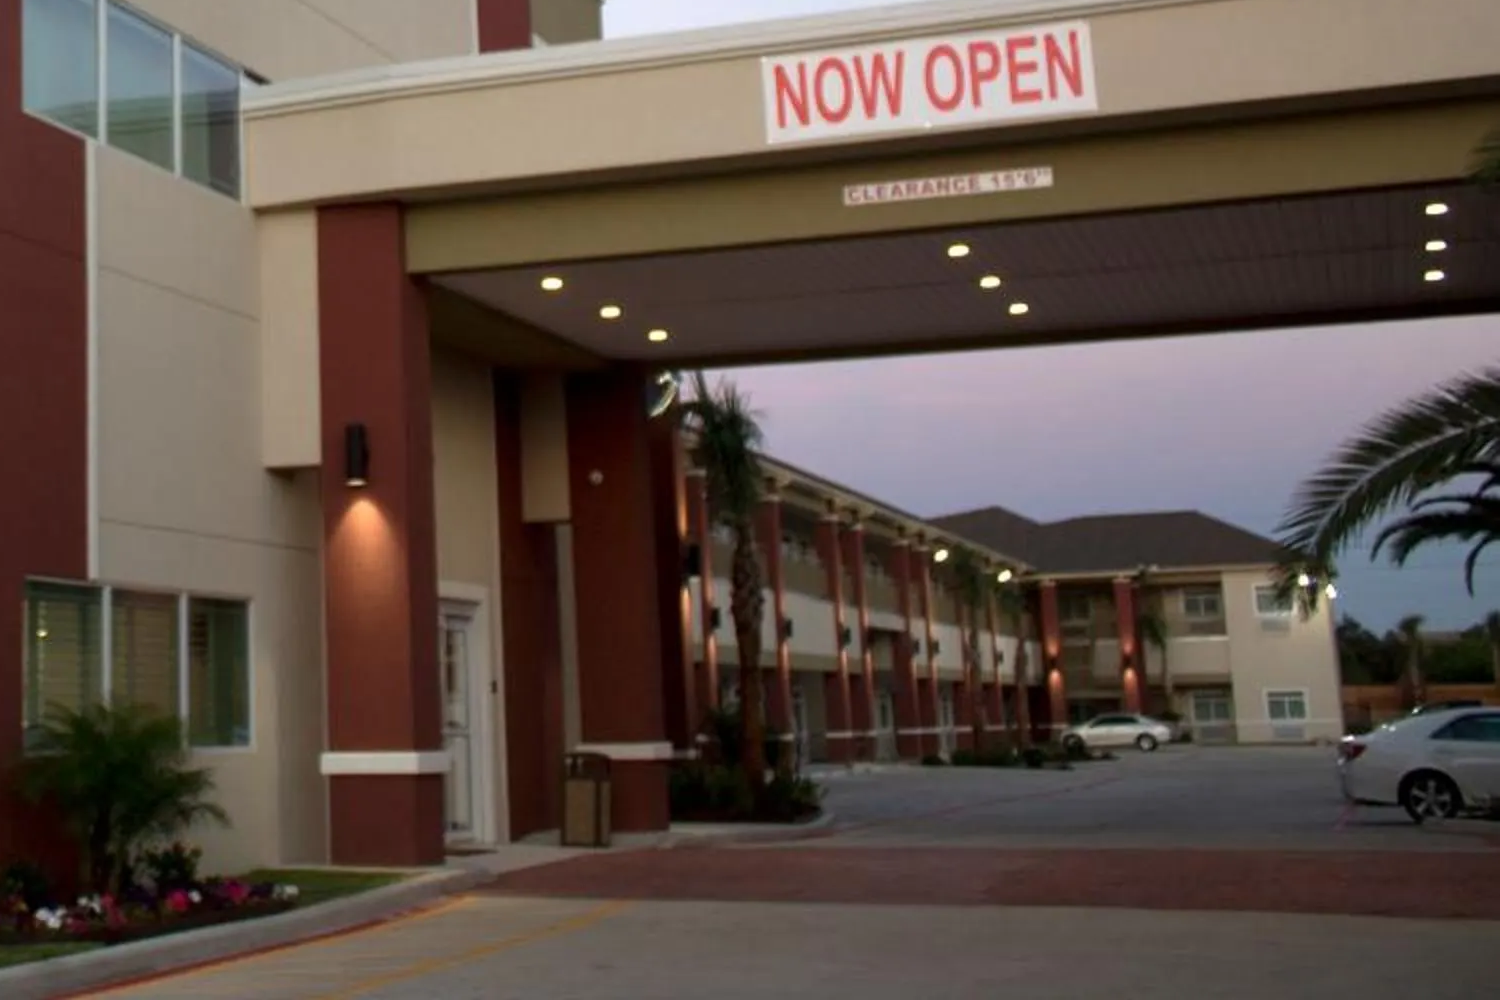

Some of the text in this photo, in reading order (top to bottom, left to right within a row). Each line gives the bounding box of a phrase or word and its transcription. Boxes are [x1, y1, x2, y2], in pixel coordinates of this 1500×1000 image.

[773, 30, 1084, 128] NOW OPEN
[848, 175, 981, 203] CLEARANCE
